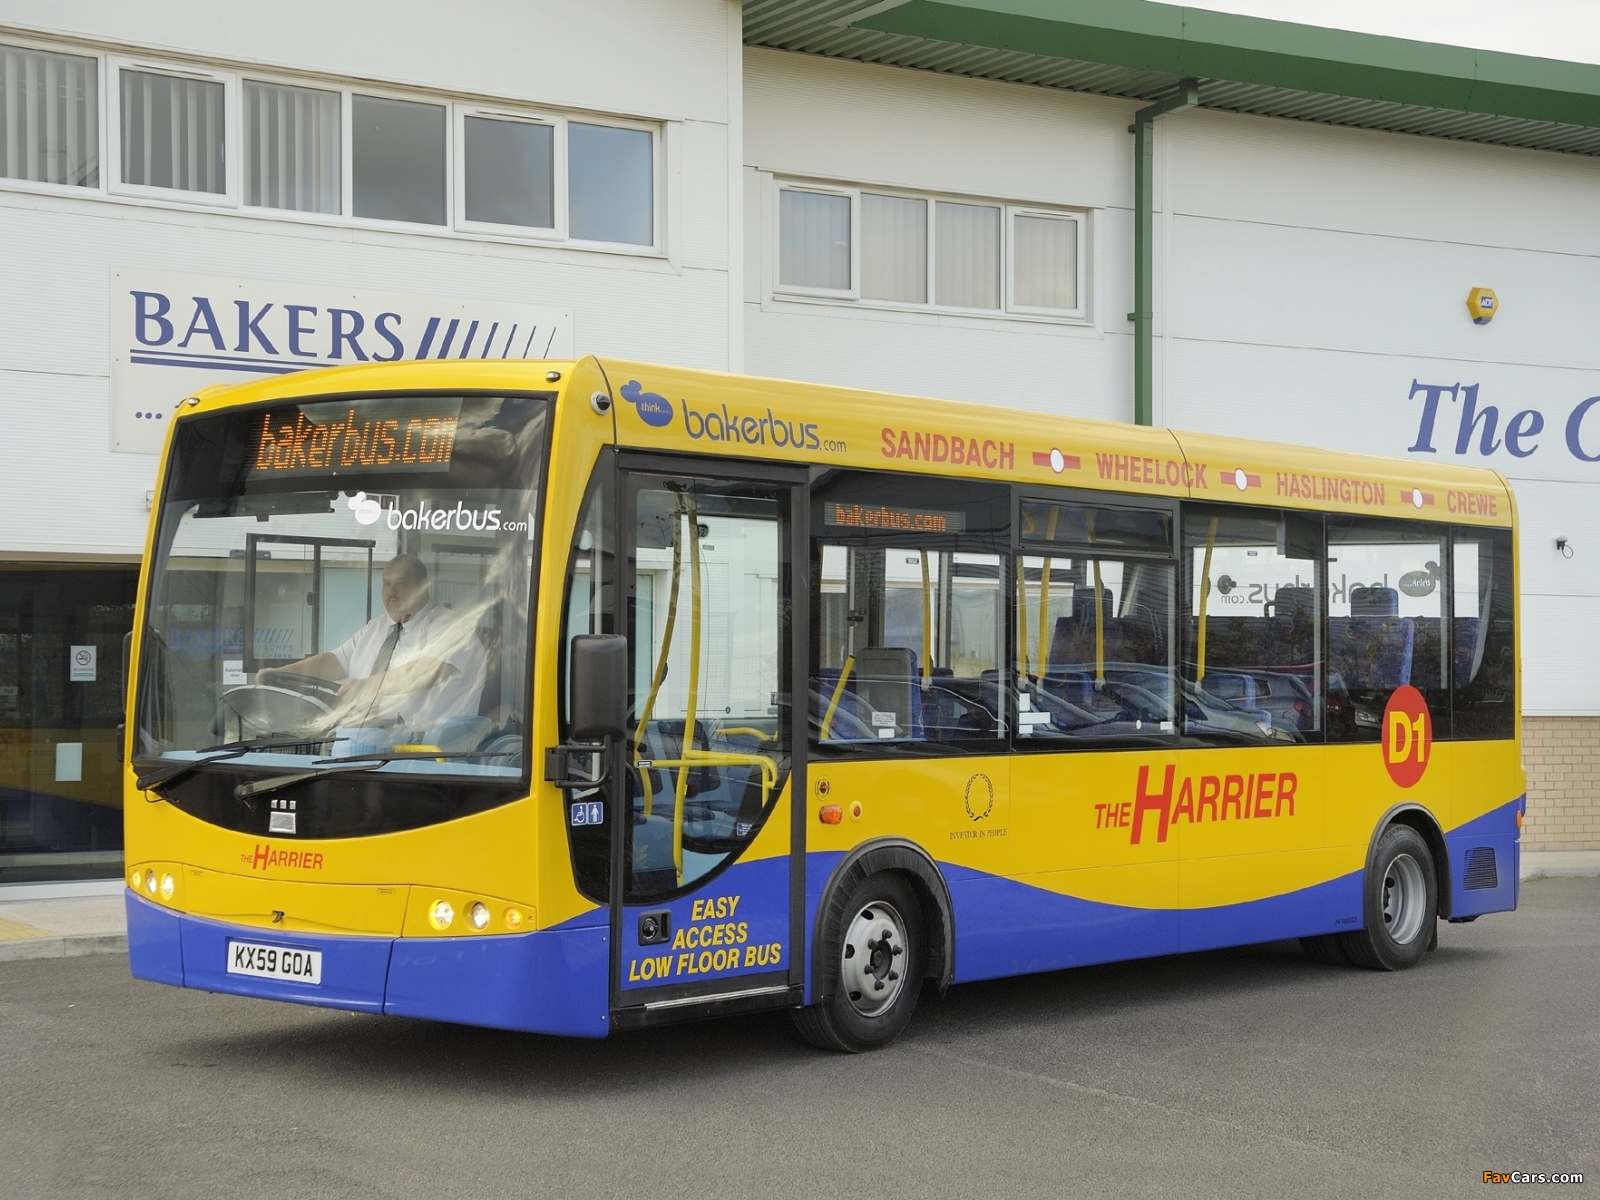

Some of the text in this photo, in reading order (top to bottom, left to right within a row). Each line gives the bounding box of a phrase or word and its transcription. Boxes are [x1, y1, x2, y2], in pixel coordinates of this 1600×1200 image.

[1481, 297, 1494, 308] ADT
[129, 290, 405, 362] BAKERS
[681, 398, 847, 453] bakerbus.com
[1407, 378, 1545, 458] The
[256, 409, 459, 470] bakerbus.com
[881, 428, 1498, 517] SANDBACH WHEELOCK HASLINGTON CREWE
[387, 501, 527, 531] bakerbus.com
[835, 503, 946, 531] bakerbus.com
[1389, 711, 1425, 764] D1
[1094, 764, 1298, 845] THE HARRIER
[949, 828, 1008, 840] INVESTOR IN PEOPLE
[240, 844, 324, 871] THE HARRIER
[691, 895, 741, 922] EASY
[671, 921, 748, 951] ACCESS
[234, 945, 313, 977] KX59 GOA
[628, 942, 782, 982] LOW FLOOR BUS
